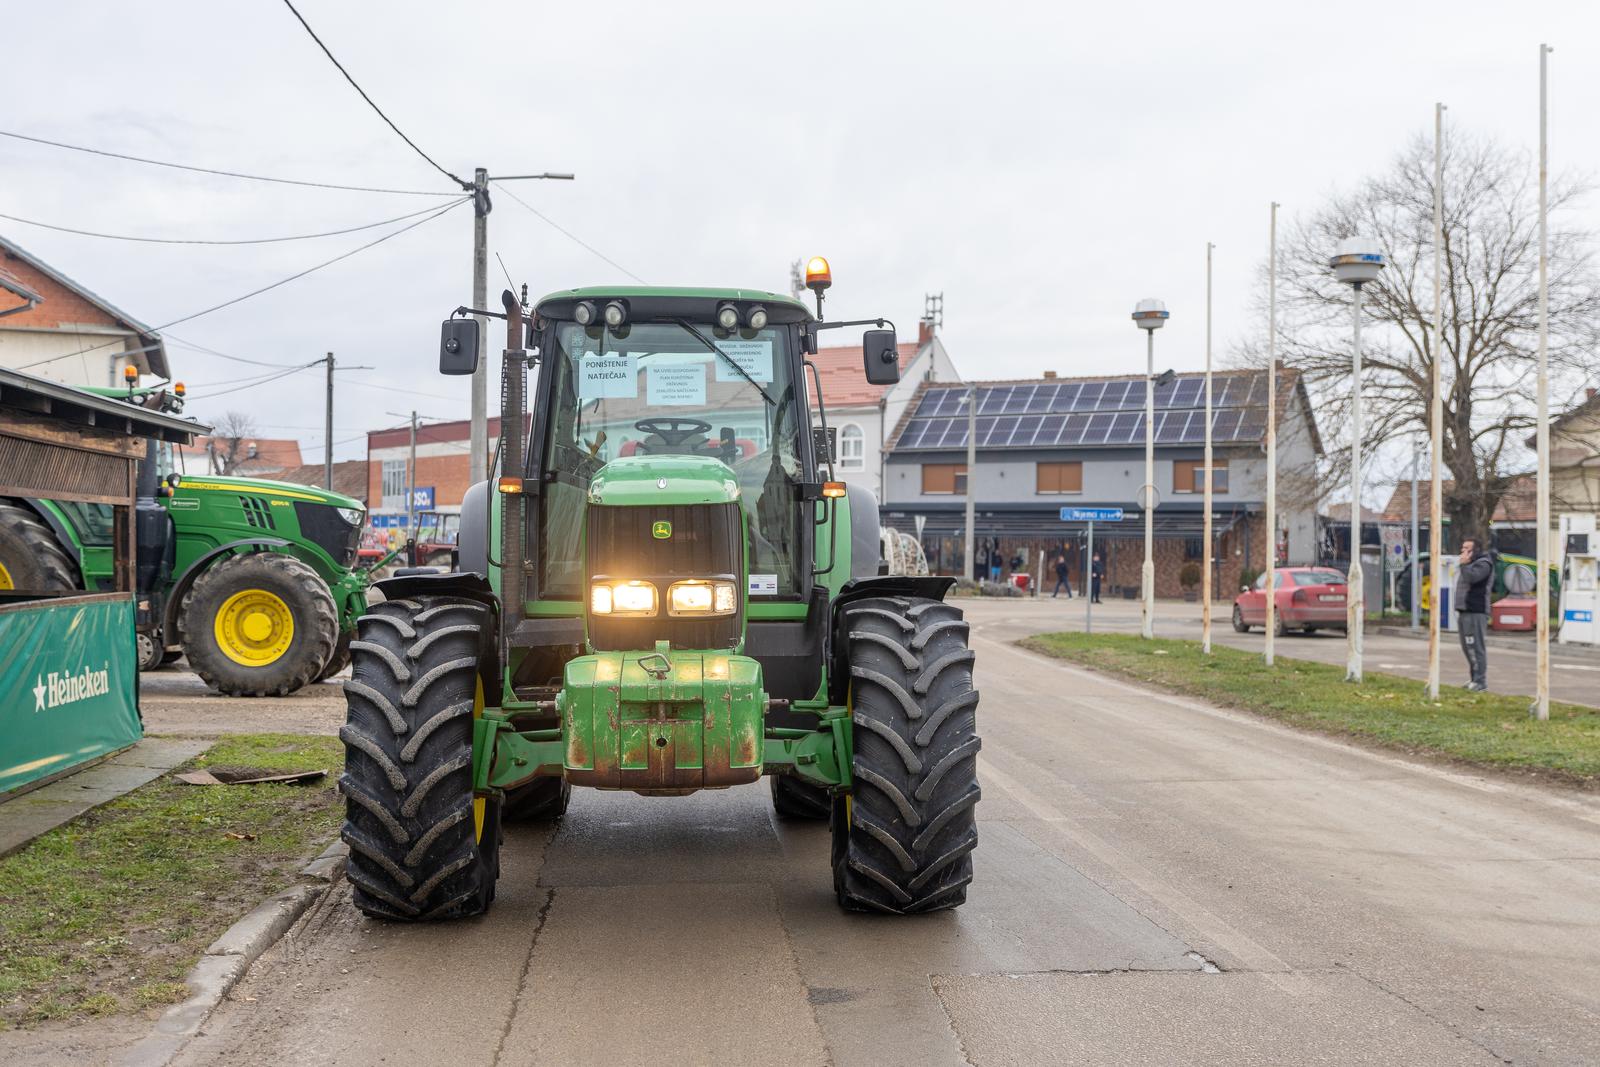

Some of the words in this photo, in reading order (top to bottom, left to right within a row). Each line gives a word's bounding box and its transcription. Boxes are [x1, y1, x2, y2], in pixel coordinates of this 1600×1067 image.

[585, 359, 628, 368] PONIŠTENJE
[587, 371, 627, 380] NATJEČAJA
[47, 665, 109, 708] Heineken
